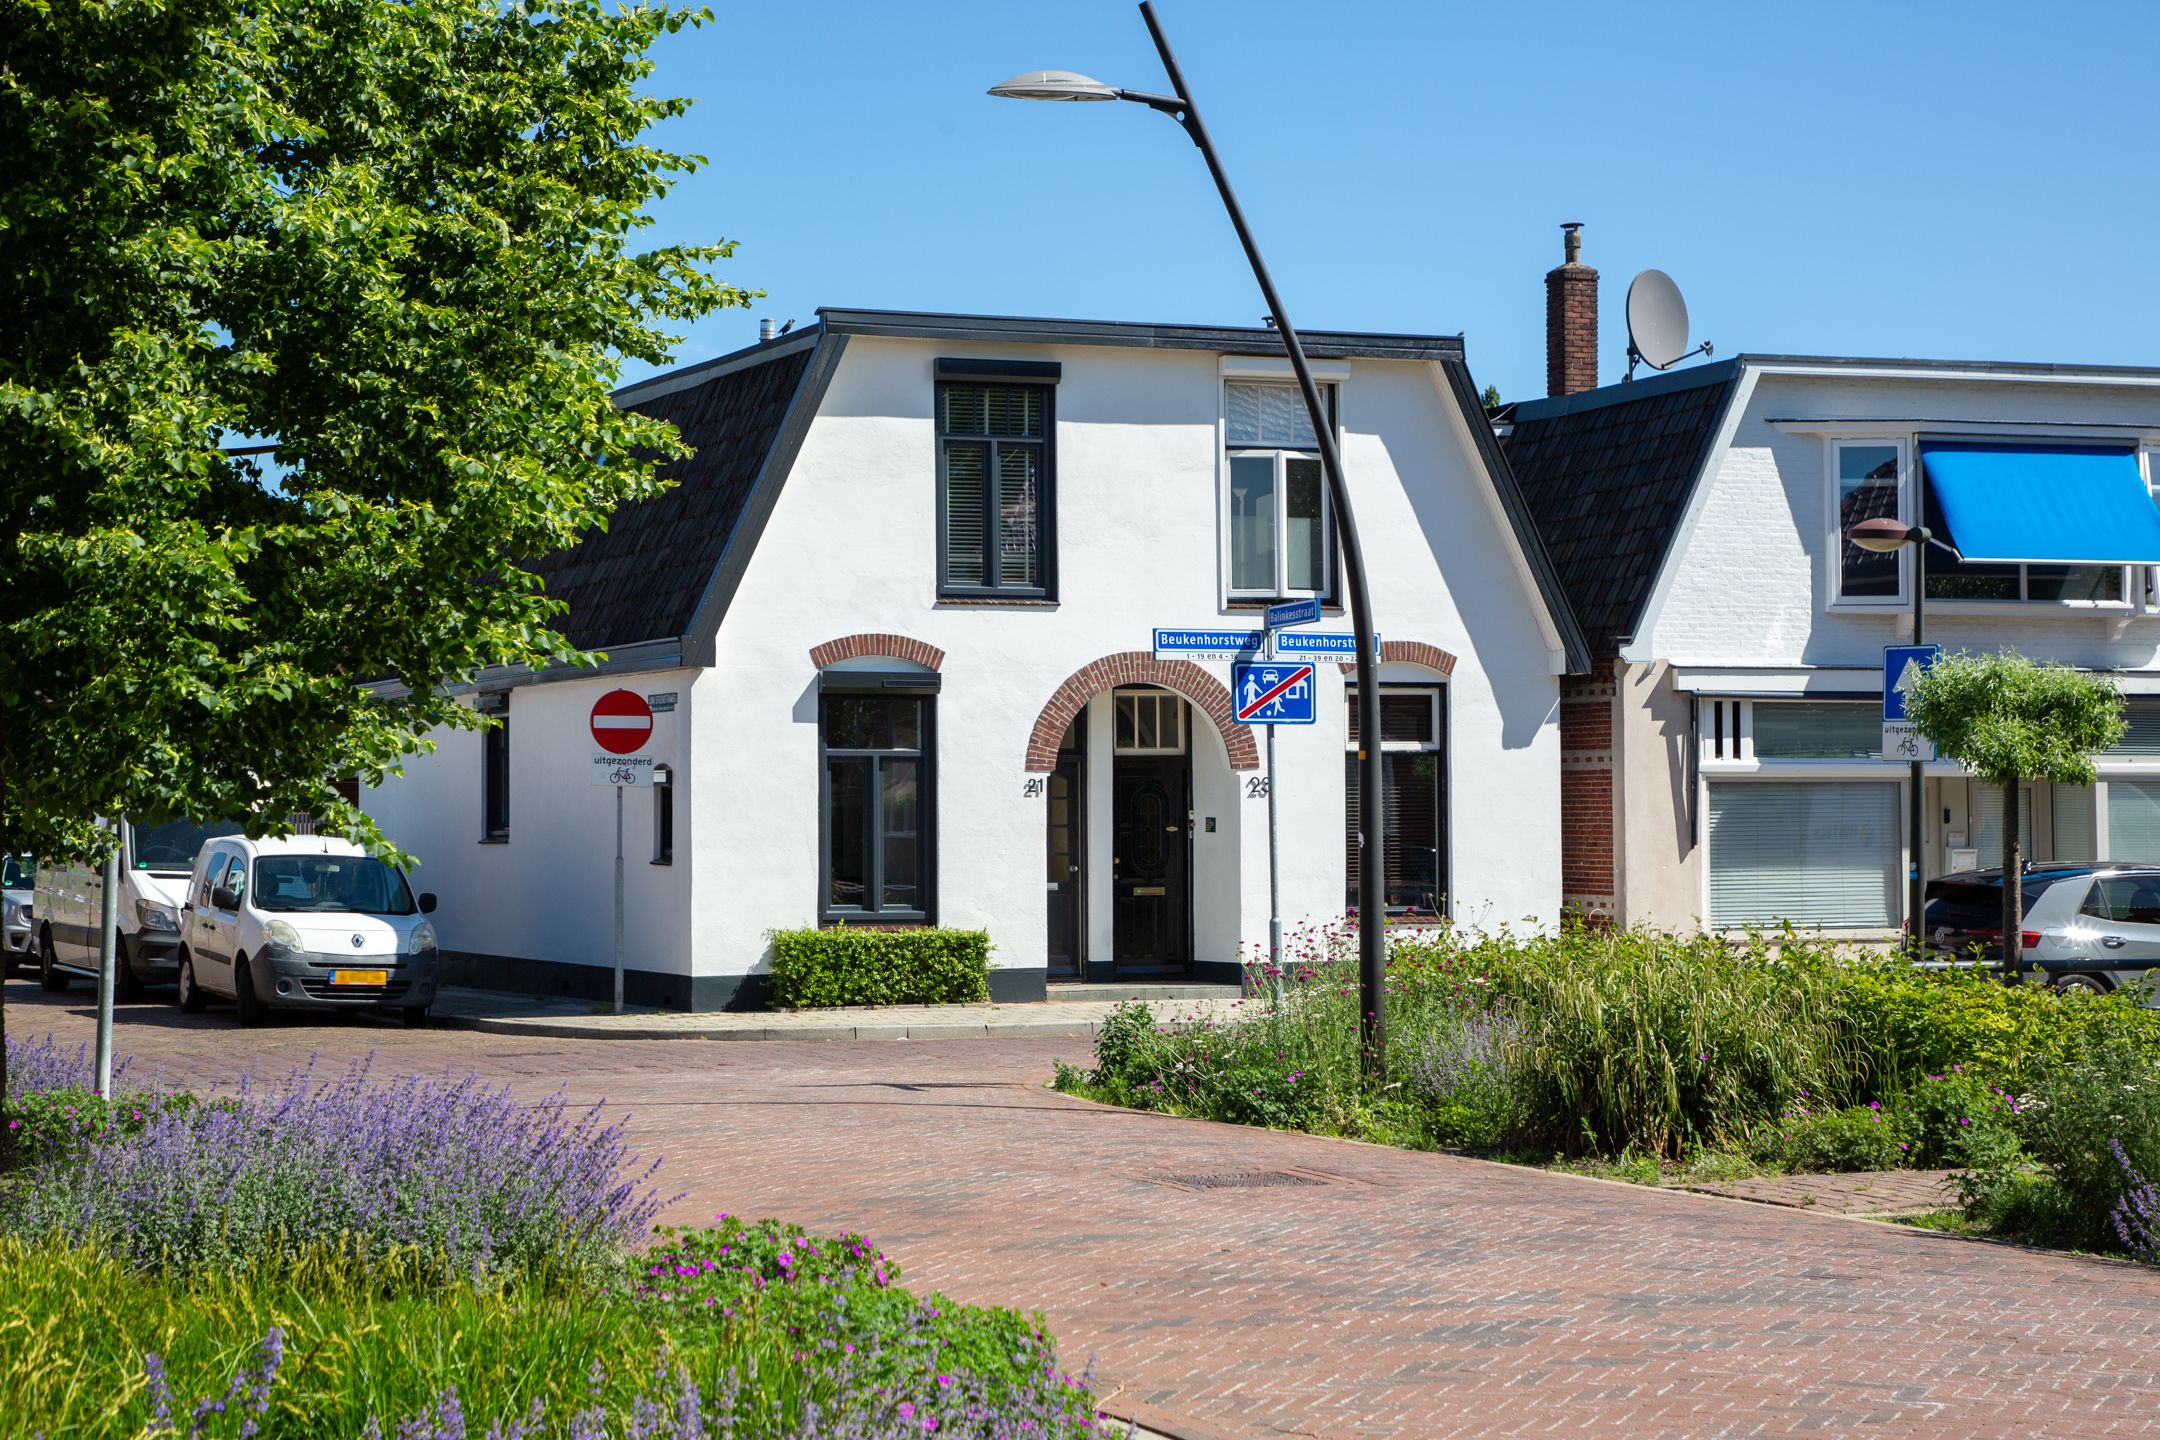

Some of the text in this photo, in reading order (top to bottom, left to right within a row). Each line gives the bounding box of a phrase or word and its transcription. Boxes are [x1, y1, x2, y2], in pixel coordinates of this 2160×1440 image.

[1270, 606, 1315, 623] Balinkesstraat
[1161, 633, 1258, 649] Beukenhorstweg
[1281, 635, 1356, 648] Beukenhorst
[594, 756, 652, 767] uitgezonderd
[1028, 778, 1043, 792] 21
[1249, 776, 1269, 793] 23
